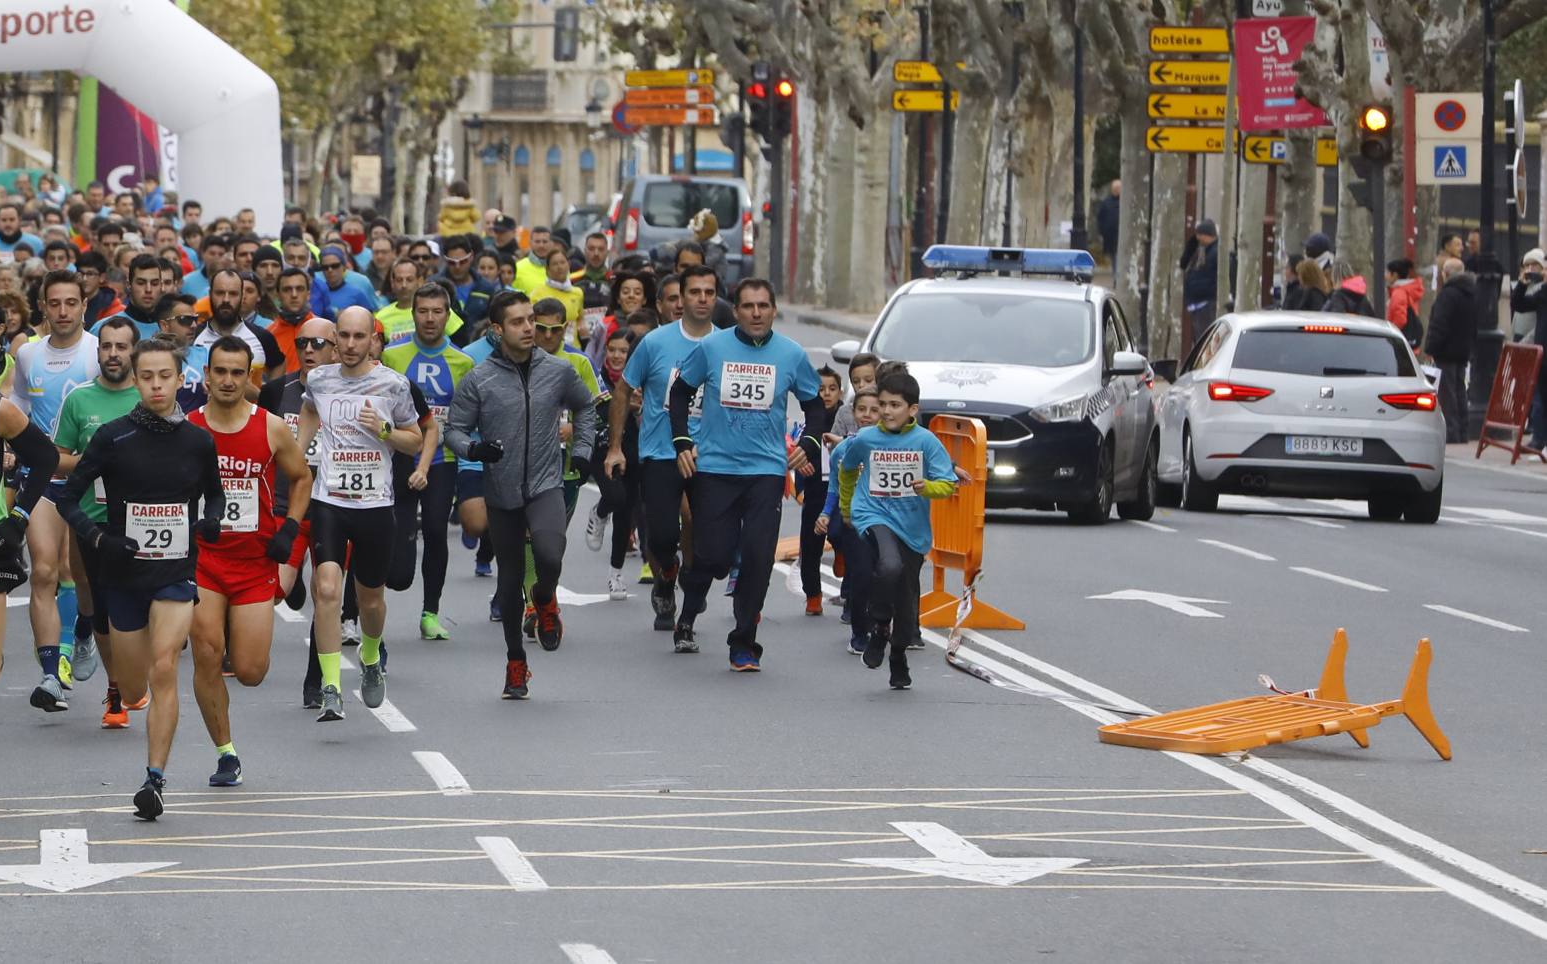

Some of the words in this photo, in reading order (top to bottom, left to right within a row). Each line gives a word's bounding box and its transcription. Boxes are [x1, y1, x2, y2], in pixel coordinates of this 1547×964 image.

[1153, 34, 1202, 46] hoteles
[1174, 72, 1220, 83] Marqués
[1194, 106, 1208, 116] La
[726, 363, 772, 376] CARRERA
[417, 362, 448, 396] R
[730, 383, 765, 401] 345
[1293, 436, 1328, 450] 8889
[1332, 438, 1358, 452] KSC
[333, 451, 381, 462] CARRERA
[873, 452, 920, 462] CARRERA
[218, 455, 262, 478] Rioja
[222, 479, 253, 491] RERA
[338, 472, 375, 491] 181
[878, 471, 914, 489] 350
[132, 504, 184, 517] CARRERA
[144, 528, 173, 549] 29
